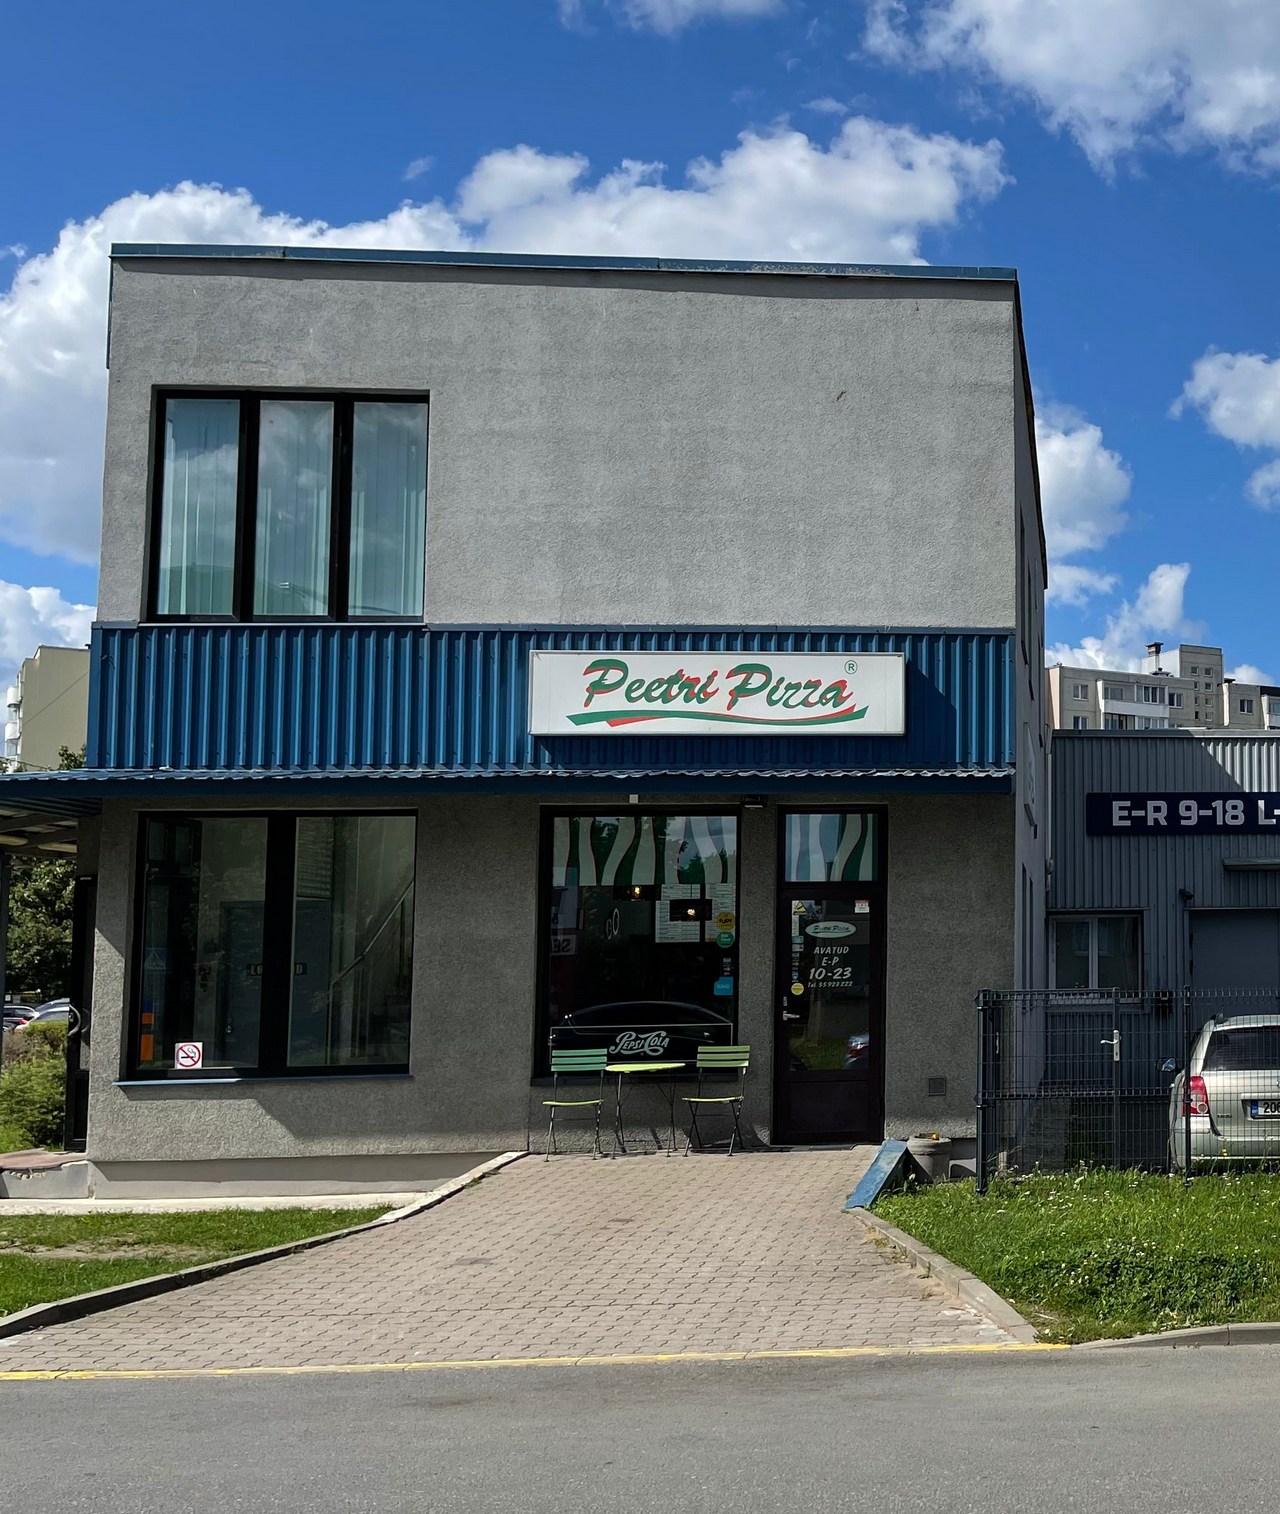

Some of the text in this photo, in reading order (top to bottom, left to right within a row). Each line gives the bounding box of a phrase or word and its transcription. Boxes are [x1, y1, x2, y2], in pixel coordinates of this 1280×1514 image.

[583, 659, 719, 708] Peetri
[726, 663, 853, 711] Pizza
[1112, 800, 1168, 826] E-R
[1178, 800, 1245, 826] 9-18
[814, 946, 849, 954] AVATUD
[821, 956, 840, 966] E-P
[809, 967, 852, 980] 10-23
